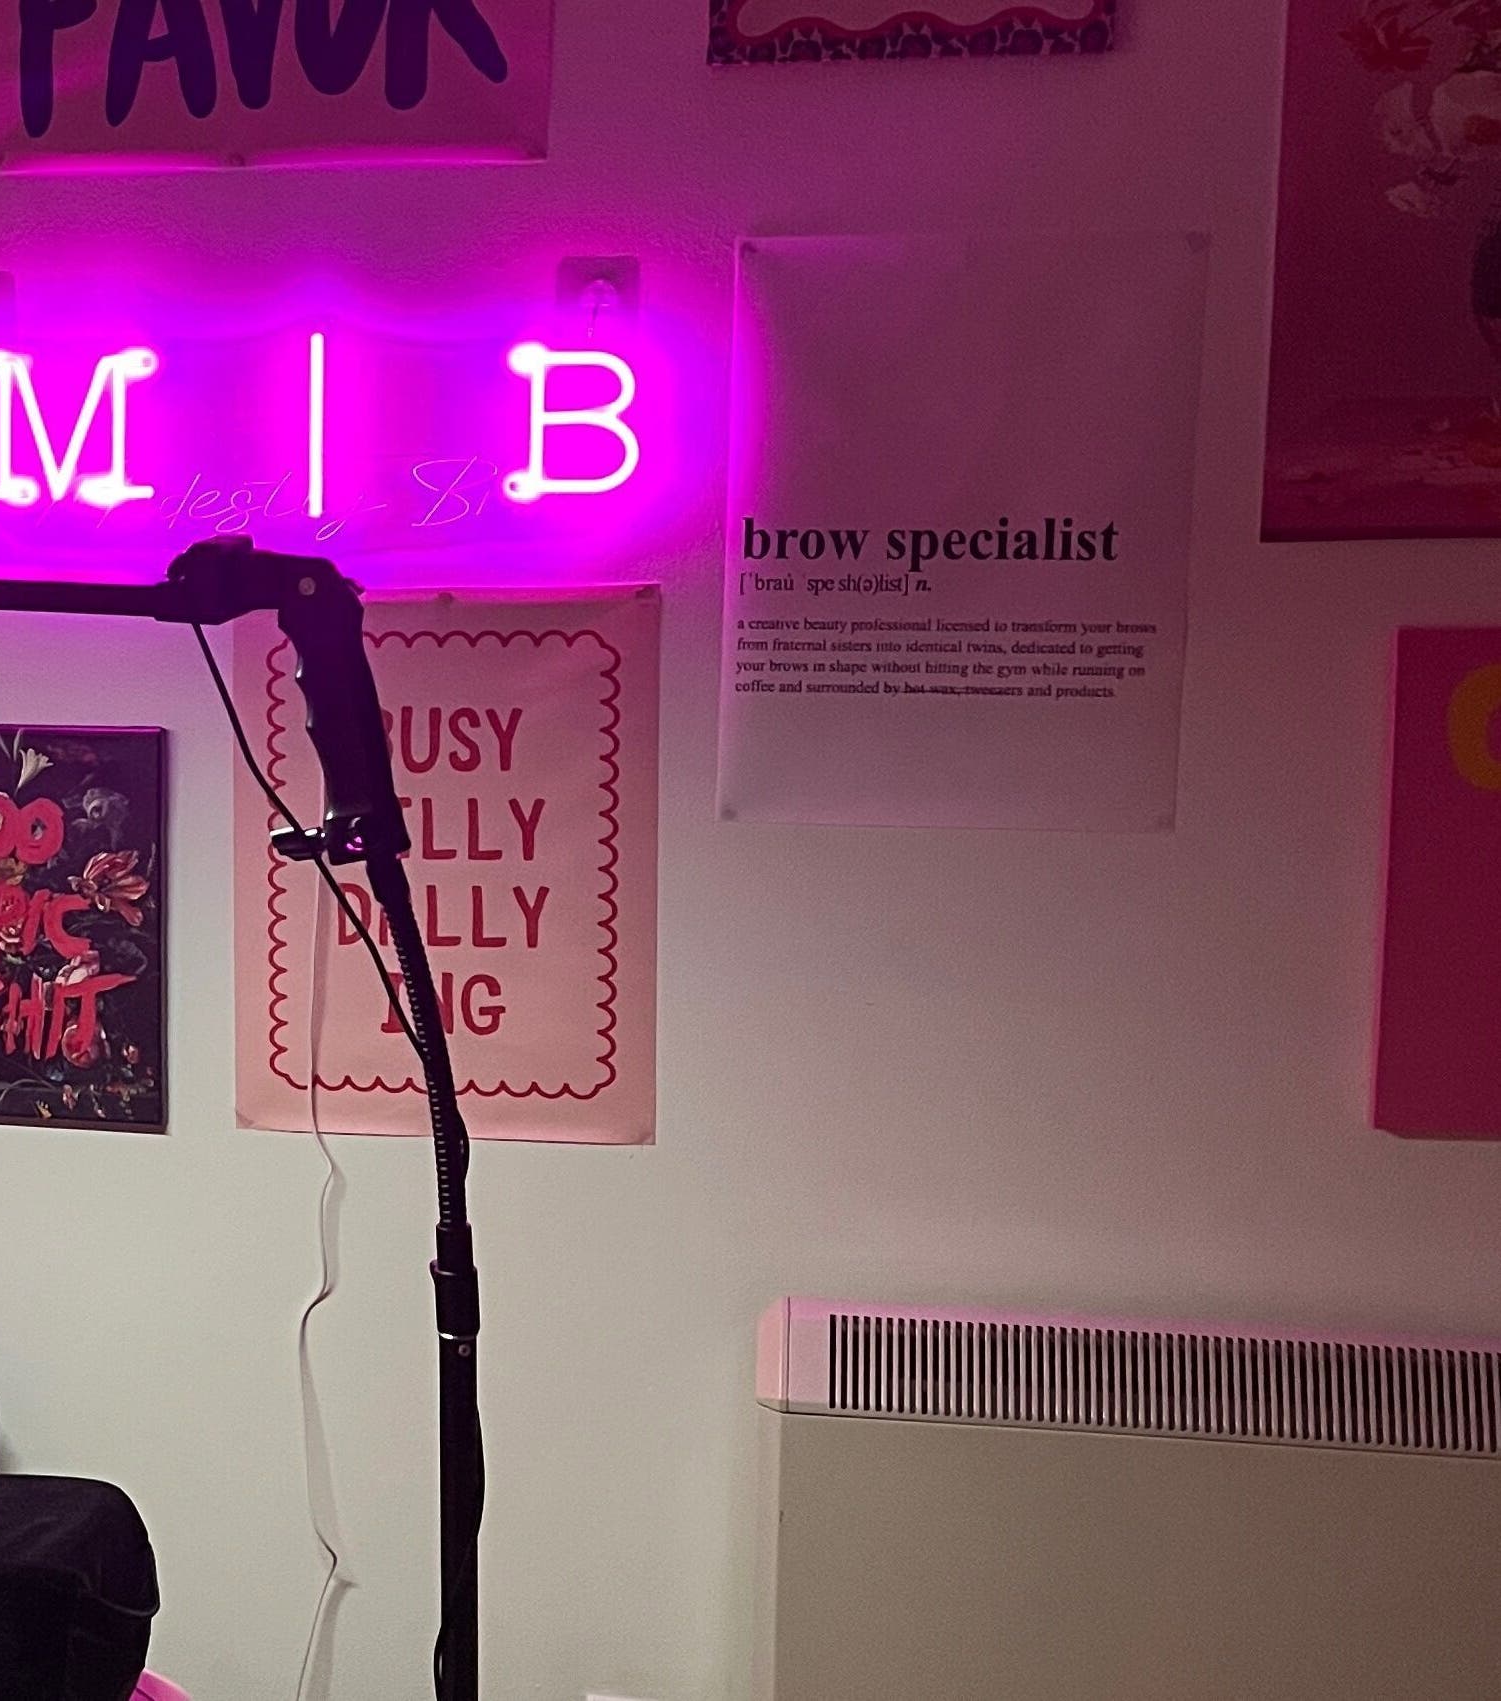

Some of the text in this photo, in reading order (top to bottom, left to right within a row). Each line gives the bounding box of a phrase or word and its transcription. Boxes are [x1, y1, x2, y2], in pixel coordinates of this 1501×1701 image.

[743, 516, 1120, 572] brow specialist
[914, 580, 932, 593] n.
[737, 616, 1157, 636] a creative beauty professional licensed to transform your brows
[737, 636, 1144, 658] from fraternal sisters into identical twins, dedicated to getting
[736, 662, 765, 675] your
[769, 658, 809, 672] brows
[812, 658, 826, 672] in
[828, 658, 867, 676] shape
[871, 659, 921, 673] without
[972, 660, 994, 674] the
[997, 664, 1027, 678] gym
[1031, 660, 1069, 675] while
[1072, 661, 1125, 679] running
[1128, 665, 1146, 676] on
[734, 679, 775, 693] coffee
[778, 679, 803, 694] and
[806, 680, 880, 695] surrounded
[883, 681, 899, 698] by
[1027, 682, 1052, 696] and
[380, 706, 523, 774] USY
[337, 883, 550, 949] DLLY
